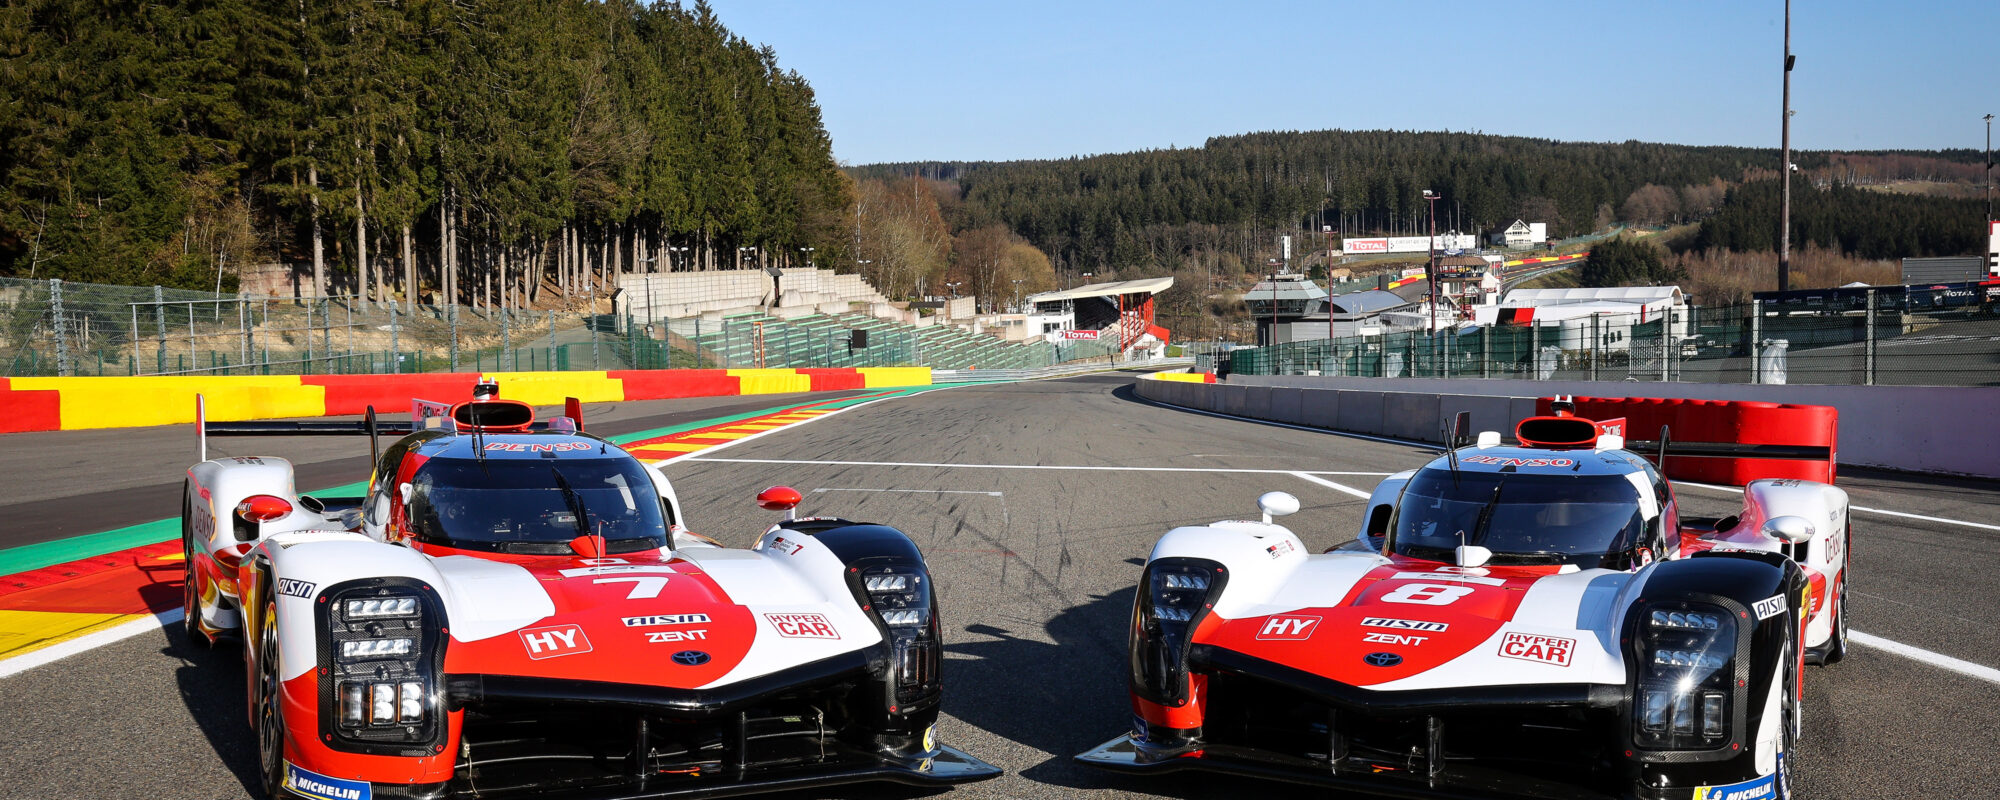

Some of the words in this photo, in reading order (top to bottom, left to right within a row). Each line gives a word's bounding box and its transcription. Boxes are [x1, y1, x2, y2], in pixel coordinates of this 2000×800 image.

[1355, 241, 1385, 249] TOTAL
[484, 441, 592, 452] DENSO
[1461, 455, 1574, 467] DENSO
[791, 544, 804, 556] 7
[278, 579, 315, 598] AISIN
[592, 576, 669, 600] 7
[1380, 583, 1475, 606] 8
[1757, 596, 1785, 618] AISIN
[627, 614, 706, 625] AISIN
[1262, 618, 1316, 635] HY
[1363, 618, 1445, 631] AISIN
[645, 630, 708, 643] ZENT
[778, 622, 834, 636] CAR
[525, 629, 576, 653] HY
[1362, 632, 1429, 646] ZENT
[1509, 634, 1569, 649] HYPER
[1505, 642, 1566, 663] CAR
[297, 777, 360, 800] MICHELIN
[1726, 782, 1772, 800] MICHELIN
